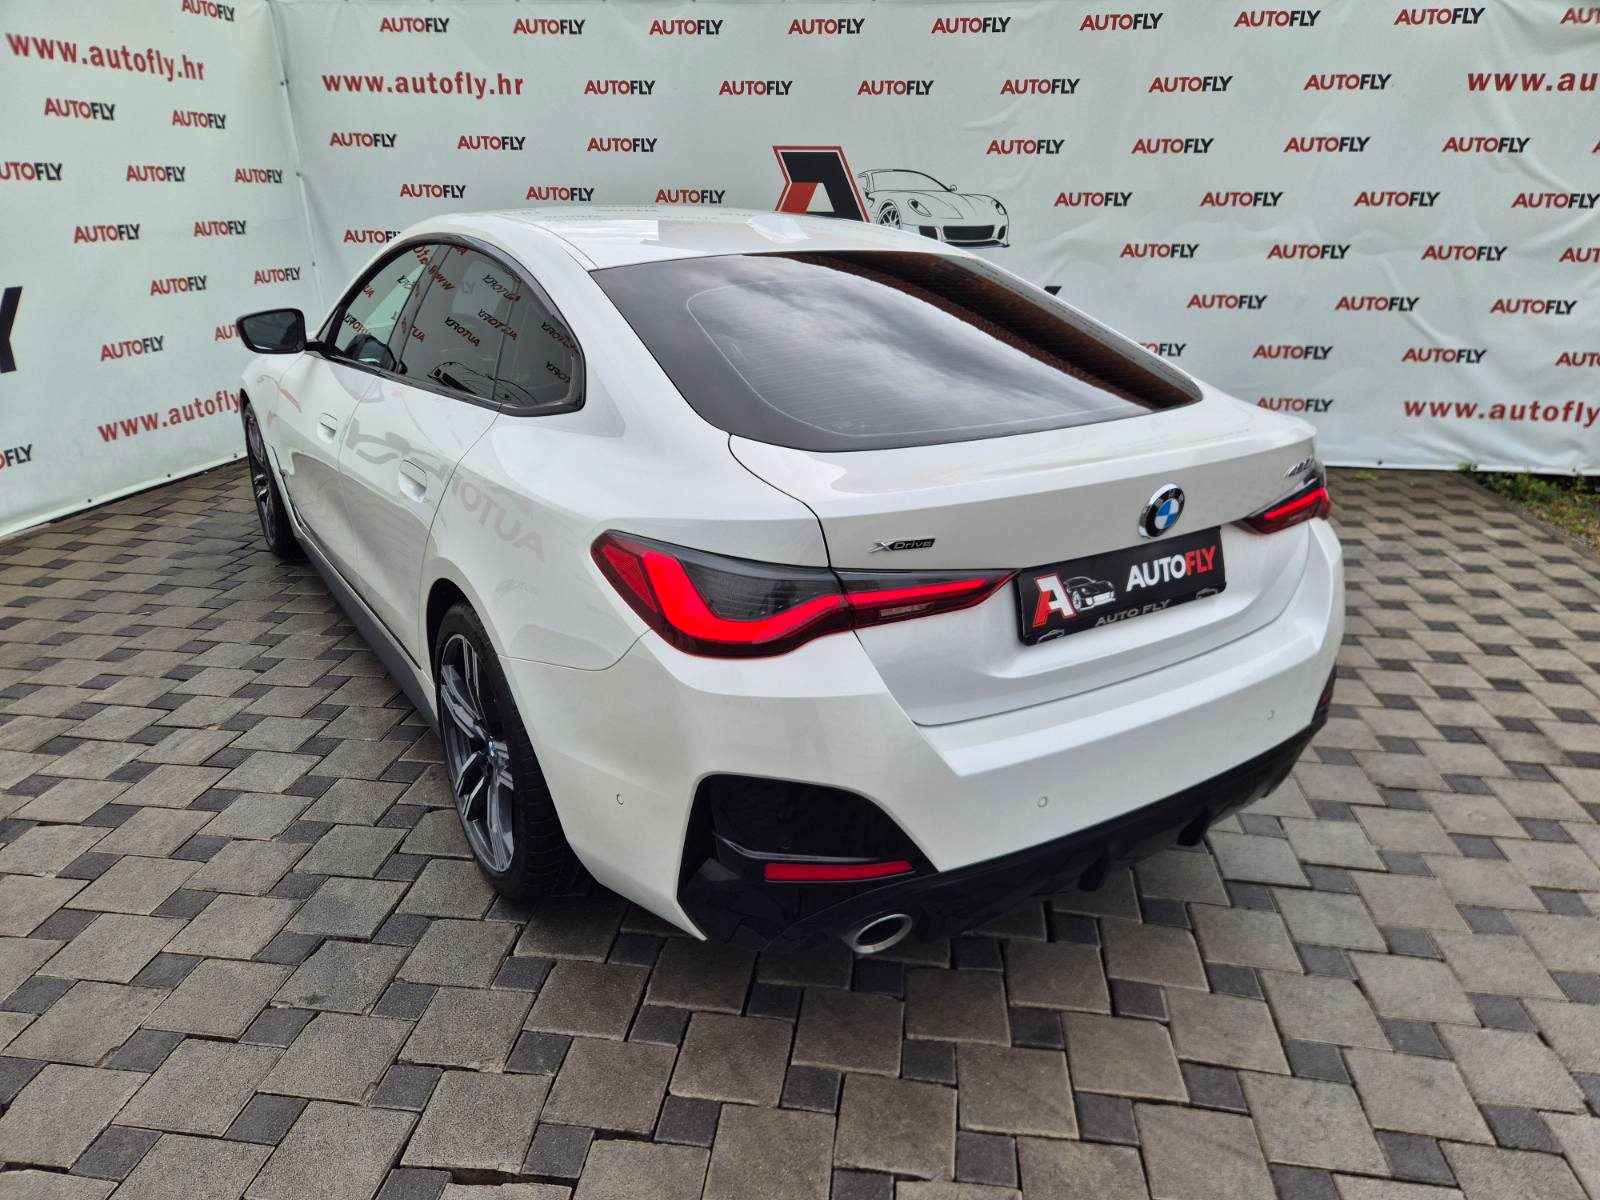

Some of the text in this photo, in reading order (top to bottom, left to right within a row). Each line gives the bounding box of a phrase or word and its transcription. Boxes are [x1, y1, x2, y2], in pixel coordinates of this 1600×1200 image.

[182, 0, 234, 22] AUTOFLY
[1234, 10, 1321, 27] AUTOFLY
[1394, 8, 1486, 25] AUTOFLY
[380, 18, 449, 32] AUTOFLY
[513, 19, 585, 35] AUTOFLY
[650, 20, 723, 35] AUTOFLY
[789, 18, 865, 34] AUTOFLY
[931, 17, 1011, 33] AUTOFLY
[1080, 13, 1163, 31] AUTOFLY
[6, 34, 203, 82] www.autofly.hr
[322, 72, 523, 99] www.autofly.hr
[584, 80, 655, 95] AUTOFLY
[719, 81, 792, 95] AUTOFLY
[858, 80, 934, 95] AUTOFLY
[1000, 79, 1080, 94] AUTOFLY
[1149, 76, 1233, 92] AUTOFLY
[1304, 74, 1392, 90] AUTOFLY
[44, 98, 115, 120] AUTOFLY
[172, 110, 226, 129] AUTOFLY
[330, 133, 396, 147] AUTOFLY
[458, 136, 525, 150] AUTOFLY
[587, 138, 657, 152] AUTOFLY
[987, 140, 1065, 154] AUTOFLY
[1132, 138, 1214, 153] AUTOFLY
[1284, 137, 1370, 152] AUTOFLY
[1442, 137, 1530, 153] AUTOFLY
[126, 166, 185, 182] AUTOFLY
[235, 169, 282, 183] AUTOFLY
[400, 184, 466, 198] AUTOFLY
[526, 187, 594, 201] AUTOFLY
[655, 190, 725, 204] AUTOFLY
[1055, 192, 1133, 206] AUTOFLY
[1200, 192, 1283, 206] AUTOFLY
[1354, 192, 1440, 207] AUTOFLY
[1512, 193, 1600, 208] AUTOFLY
[74, 224, 140, 243] AUTOFLY
[194, 220, 246, 236] AUTOFLY
[1120, 244, 1199, 258] AUTOFLY
[1268, 245, 1351, 259] AUTOFLY
[1422, 246, 1508, 261] AUTOFLY
[254, 267, 300, 284] AUTOFLY
[151, 275, 207, 296] AUTOFLY
[1187, 295, 1267, 309] AUTOFLY
[1335, 297, 1419, 312] AUTOFLY
[1490, 299, 1577, 315] AUTOFLY
[101, 336, 163, 361] AUTOFLY
[1253, 345, 1333, 360] AUTOFLY
[1402, 348, 1487, 363] AUTOFLY
[1257, 398, 1333, 412] AUTOFLY
[1126, 545, 1217, 592] AUTOFLY
